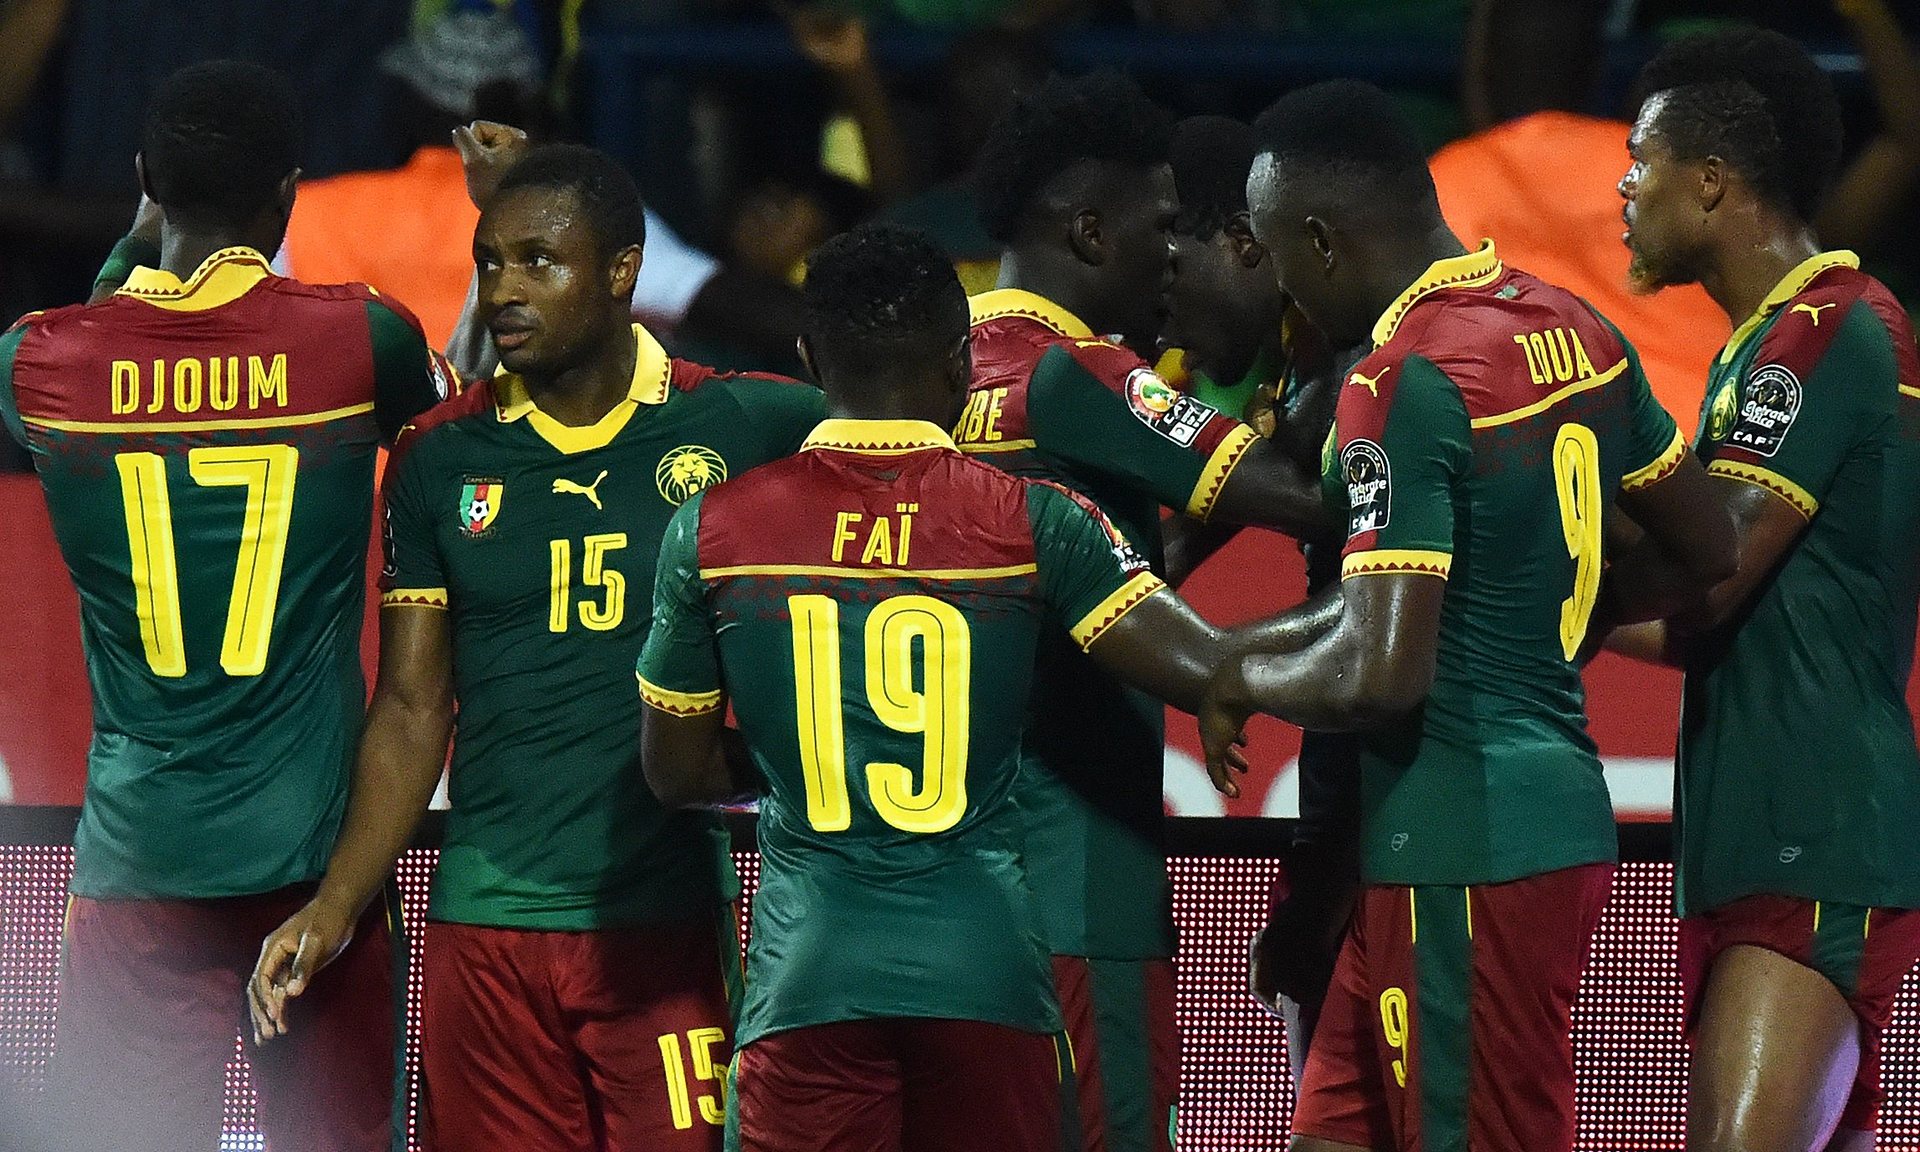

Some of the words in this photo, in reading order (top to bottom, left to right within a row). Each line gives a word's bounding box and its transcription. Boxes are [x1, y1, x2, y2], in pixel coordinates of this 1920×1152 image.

[112, 354, 289, 414] DJOUM
[1514, 328, 1596, 385] ZOUA
[1733, 431, 1767, 445] CAF
[116, 444, 299, 678] 17
[549, 532, 628, 633] 15
[832, 502, 918, 566] FAÏ
[1552, 423, 1603, 662] 9
[788, 595, 971, 833] 19
[657, 1026, 727, 1131] 15
[1379, 987, 1409, 1089] 9
